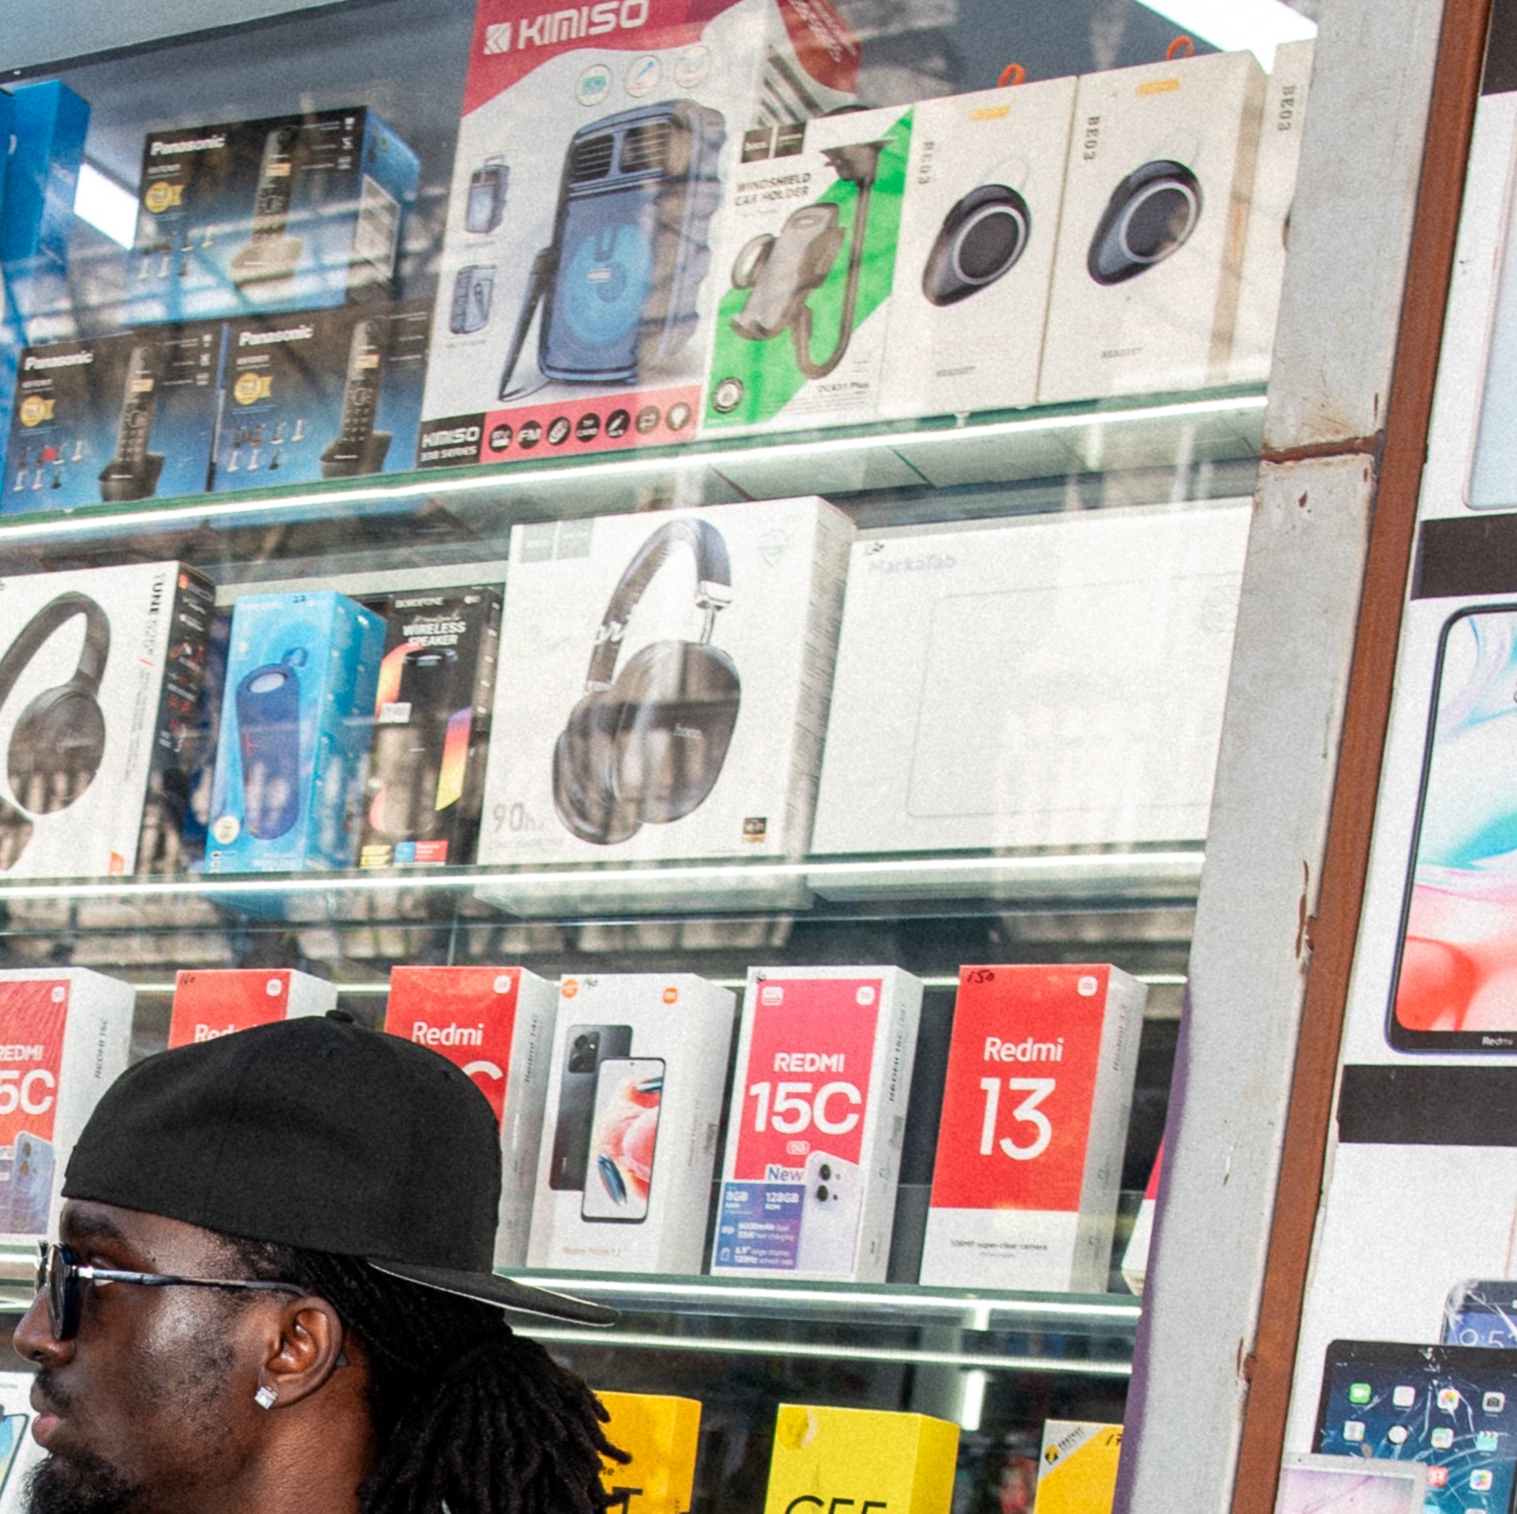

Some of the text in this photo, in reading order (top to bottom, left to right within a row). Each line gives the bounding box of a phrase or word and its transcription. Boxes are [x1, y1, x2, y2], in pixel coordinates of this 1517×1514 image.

[517, 0, 651, 49] KIMISO
[150, 133, 226, 156] Panasonic
[737, 172, 812, 192] WINDSHIELD
[735, 186, 809, 207] CAR HOLDER
[239, 324, 313, 346] Panasonic
[24, 349, 94, 371] Panasonic
[422, 426, 480, 448] KIMISO
[150, 572, 167, 614] TUNE
[402, 621, 467, 637] WIRELESS
[406, 633, 459, 647] SPEAKER
[195, 1022, 255, 1044] Red
[412, 1022, 483, 1047] Redmi
[1482, 1035, 1514, 1047] Redmi
[984, 1037, 1064, 1063] Redmi
[774, 1052, 845, 1074] REDMI
[749, 1081, 863, 1135] 15C
[980, 1077, 1056, 1161] 13
[767, 1167, 804, 1181] New
